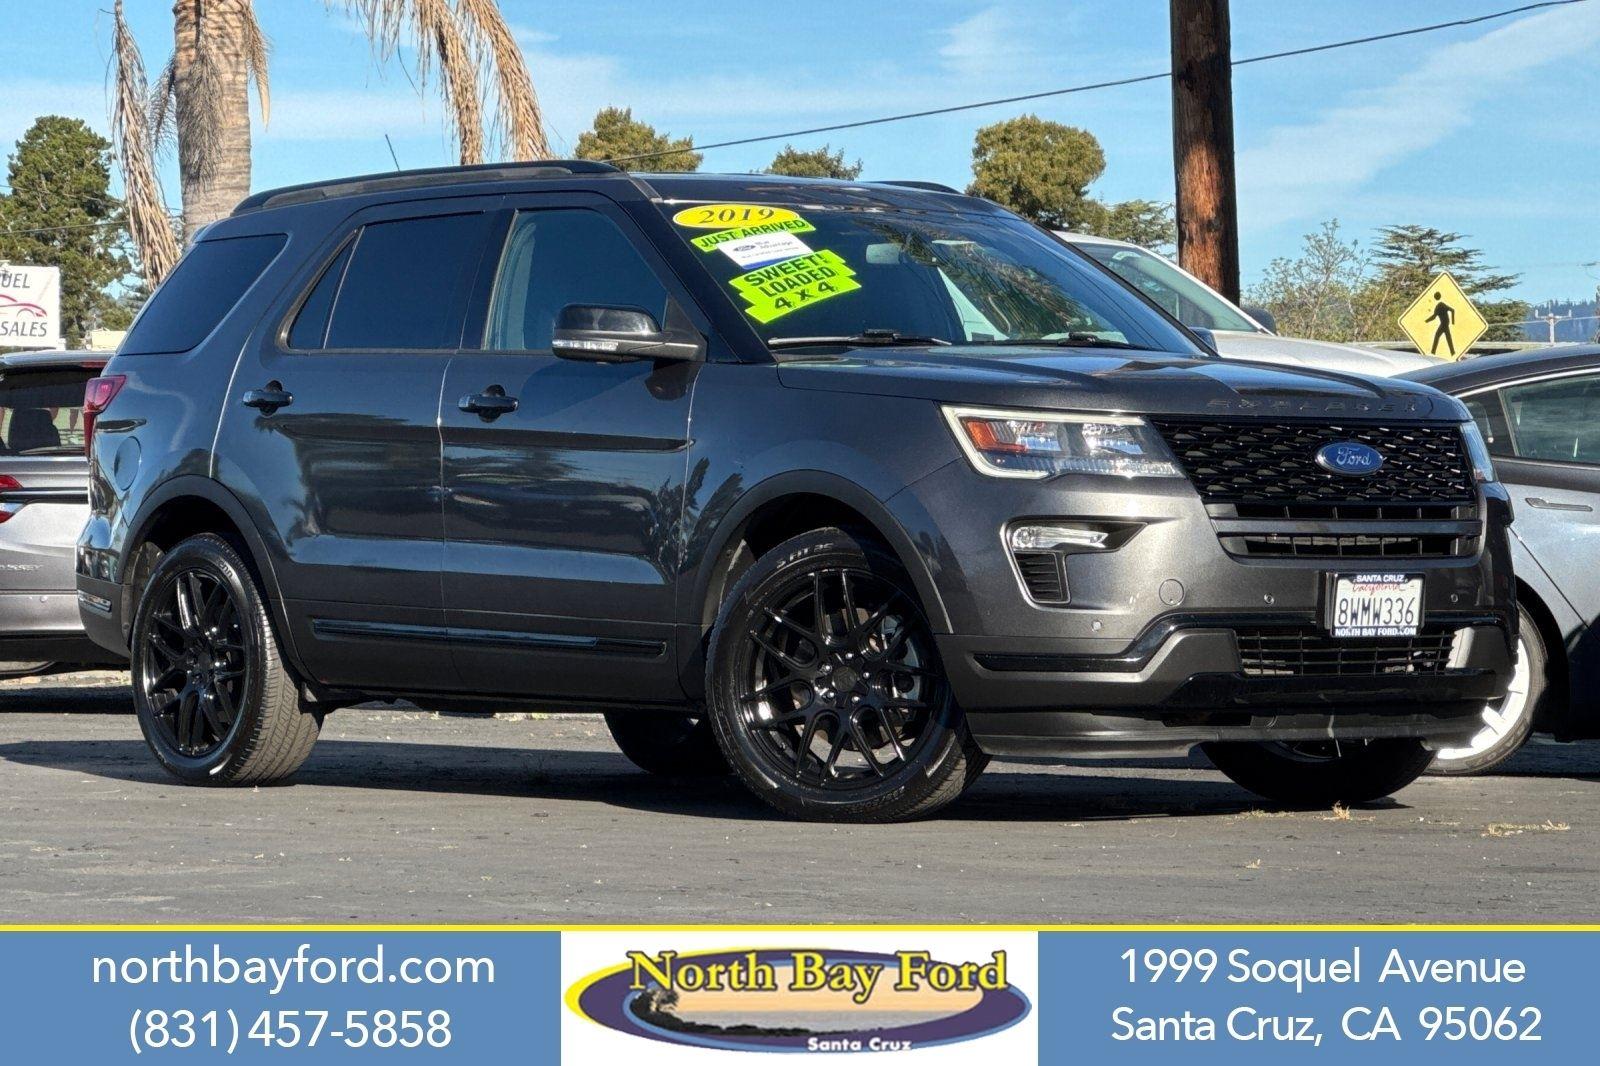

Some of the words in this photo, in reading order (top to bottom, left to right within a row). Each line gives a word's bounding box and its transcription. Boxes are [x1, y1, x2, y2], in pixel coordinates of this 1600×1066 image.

[699, 208, 775, 224] 2019
[700, 231, 738, 248] JUST
[742, 219, 806, 238] ARRIVED
[743, 253, 830, 287] SWEET!
[758, 266, 838, 297] LOADED
[774, 296, 793, 311] 4
[817, 281, 837, 294] 4
[0, 321, 47, 337] SALES
[1337, 446, 1371, 466] Ford
[1356, 574, 1382, 583] SANTA
[1383, 574, 1405, 583] CRUZ
[1338, 597, 1416, 625] 8WMW336
[1362, 627, 1377, 636] BAY
